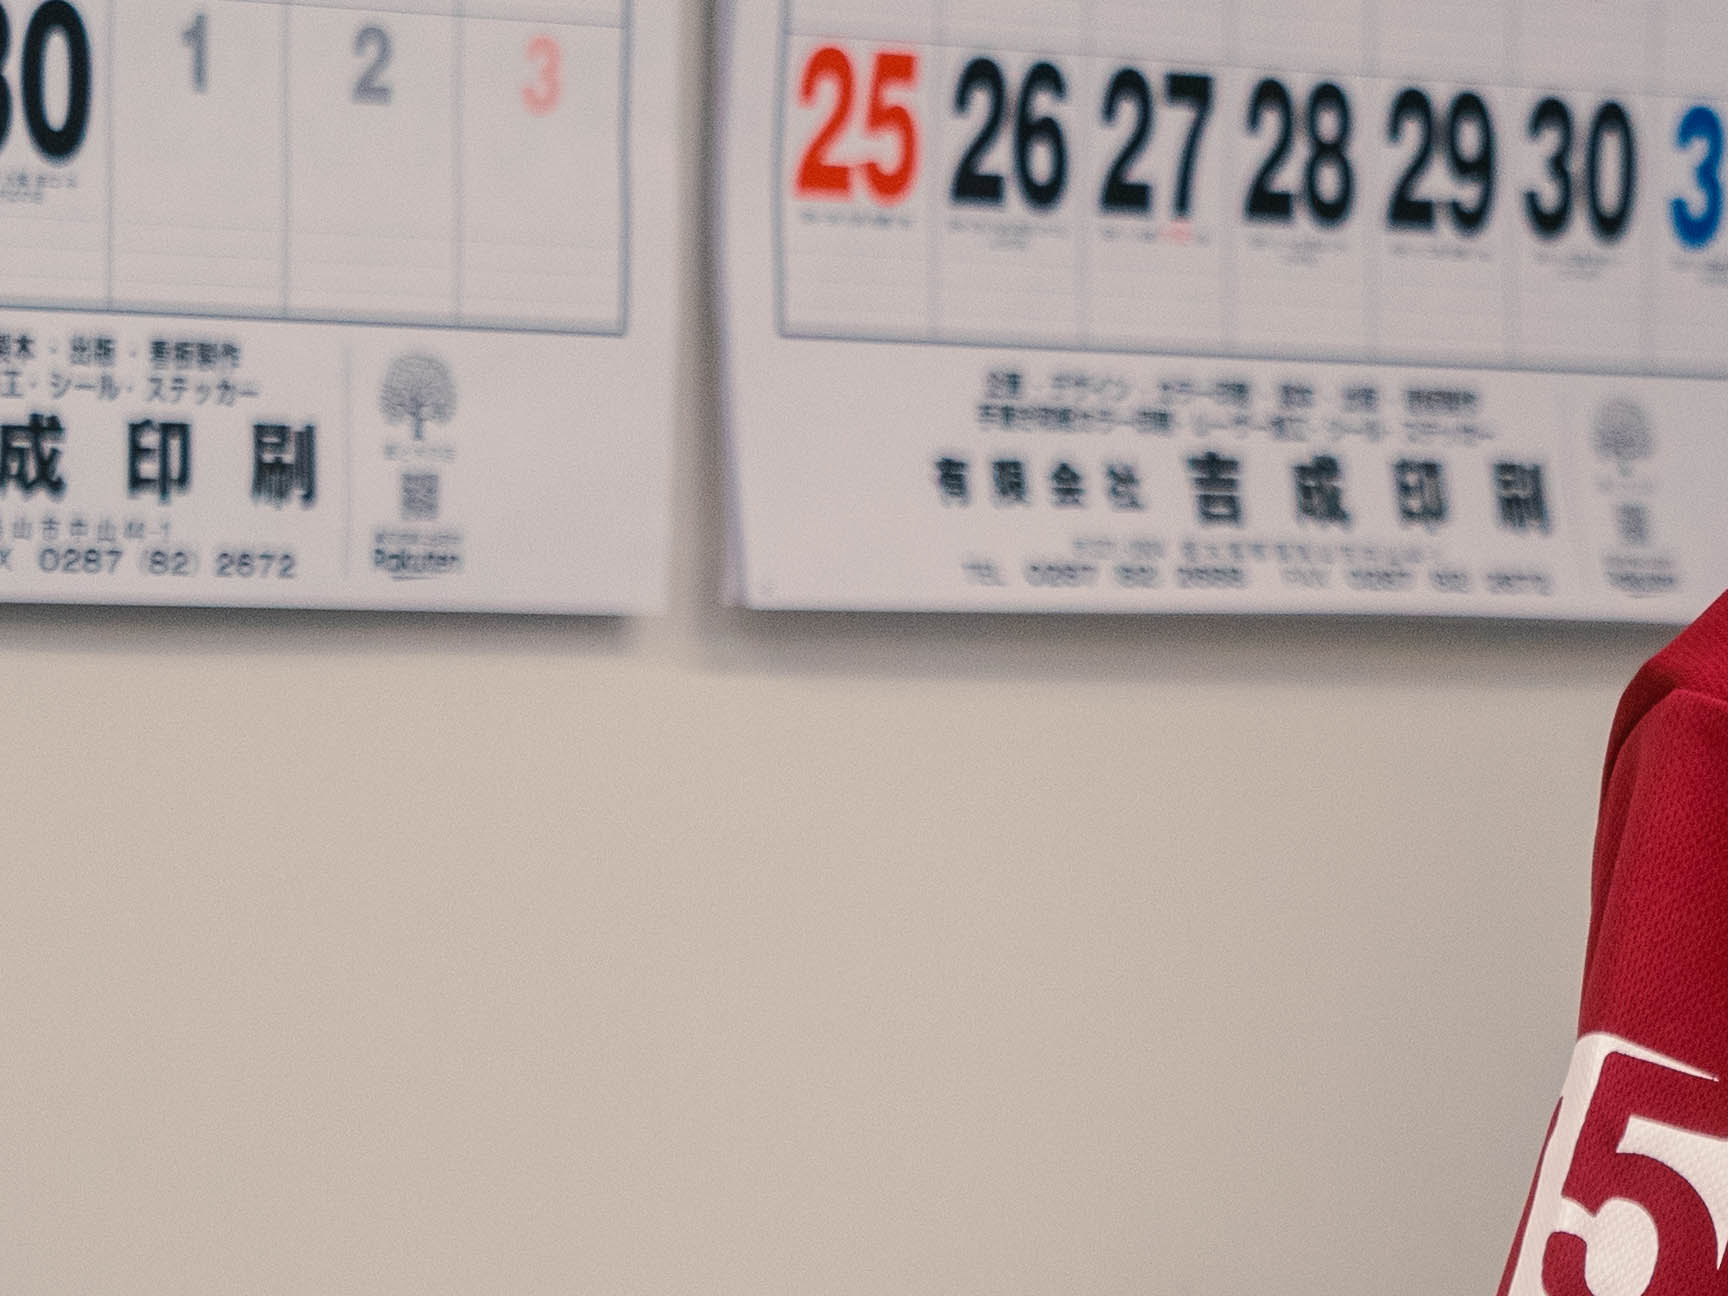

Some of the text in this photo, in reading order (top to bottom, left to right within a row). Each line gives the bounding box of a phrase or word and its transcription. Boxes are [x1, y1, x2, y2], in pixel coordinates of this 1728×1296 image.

[182, 14, 207, 90] 1
[354, 25, 392, 102] 2
[522, 35, 561, 114] 3
[797, 47, 916, 200] 25
[952, 57, 1067, 210] 26
[1100, 67, 1213, 216] 27
[1245, 78, 1354, 226] 28
[1388, 88, 1495, 234] 29
[1525, 97, 1636, 241] 30
